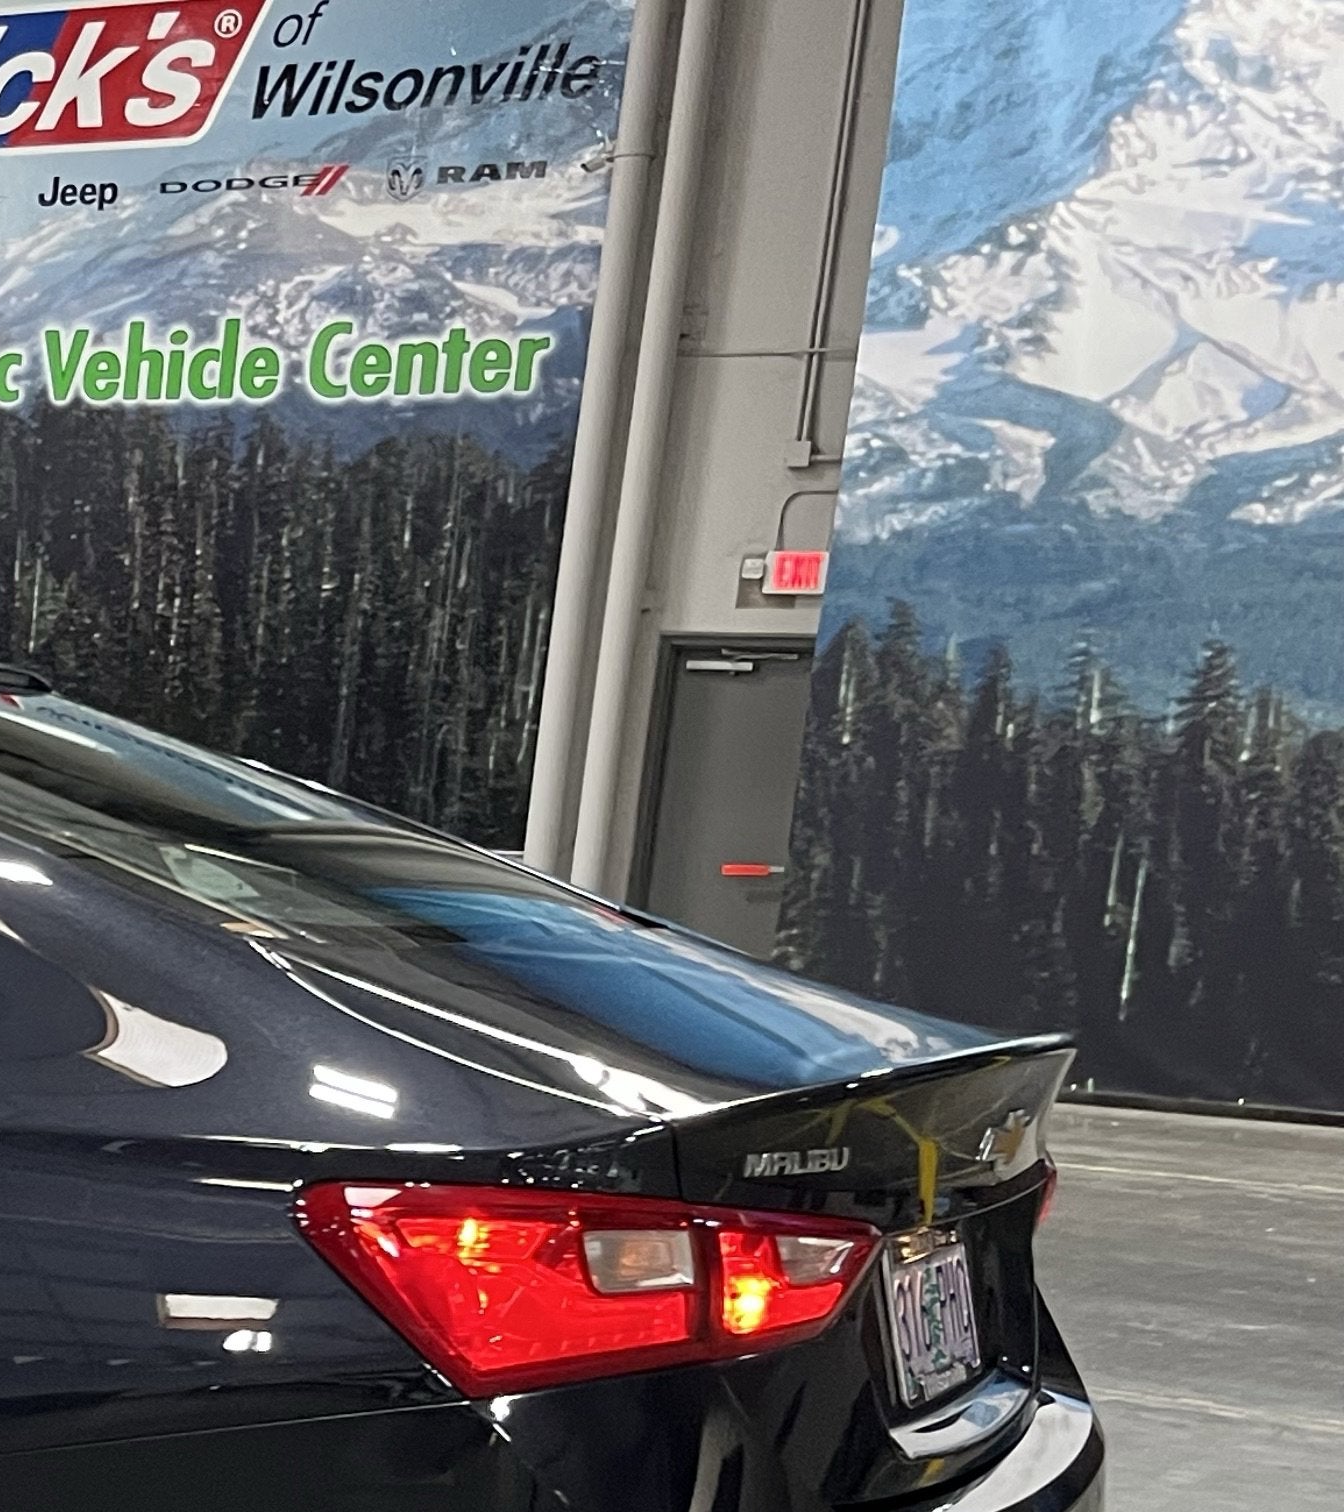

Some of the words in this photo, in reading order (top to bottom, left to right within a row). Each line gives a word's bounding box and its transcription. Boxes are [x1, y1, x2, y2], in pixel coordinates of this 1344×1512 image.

[273, 0, 330, 48] of
[251, 37, 602, 121] Wilsonville
[159, 173, 321, 195] DODGE
[437, 160, 548, 185] RAM
[38, 176, 119, 211] Jeep
[44, 318, 280, 401] Vehicle
[311, 321, 551, 399] Center
[743, 1146, 850, 1178] MALIBU
